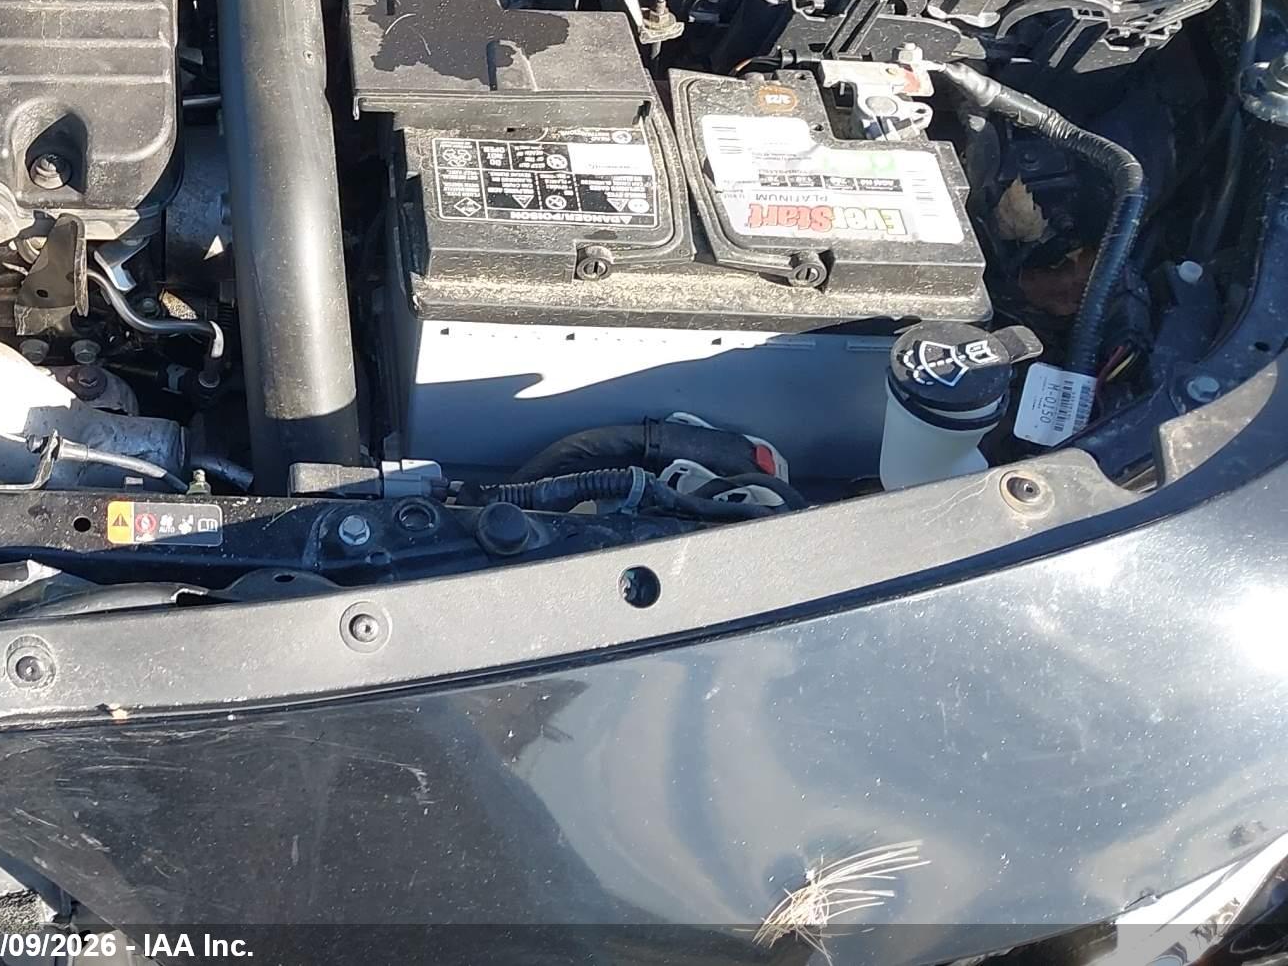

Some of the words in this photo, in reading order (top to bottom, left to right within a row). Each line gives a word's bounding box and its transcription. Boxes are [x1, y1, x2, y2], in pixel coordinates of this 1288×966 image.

[755, 193, 828, 203] PLATINUM
[749, 204, 908, 235] EverStart
[158, 526, 176, 534] AUTO
